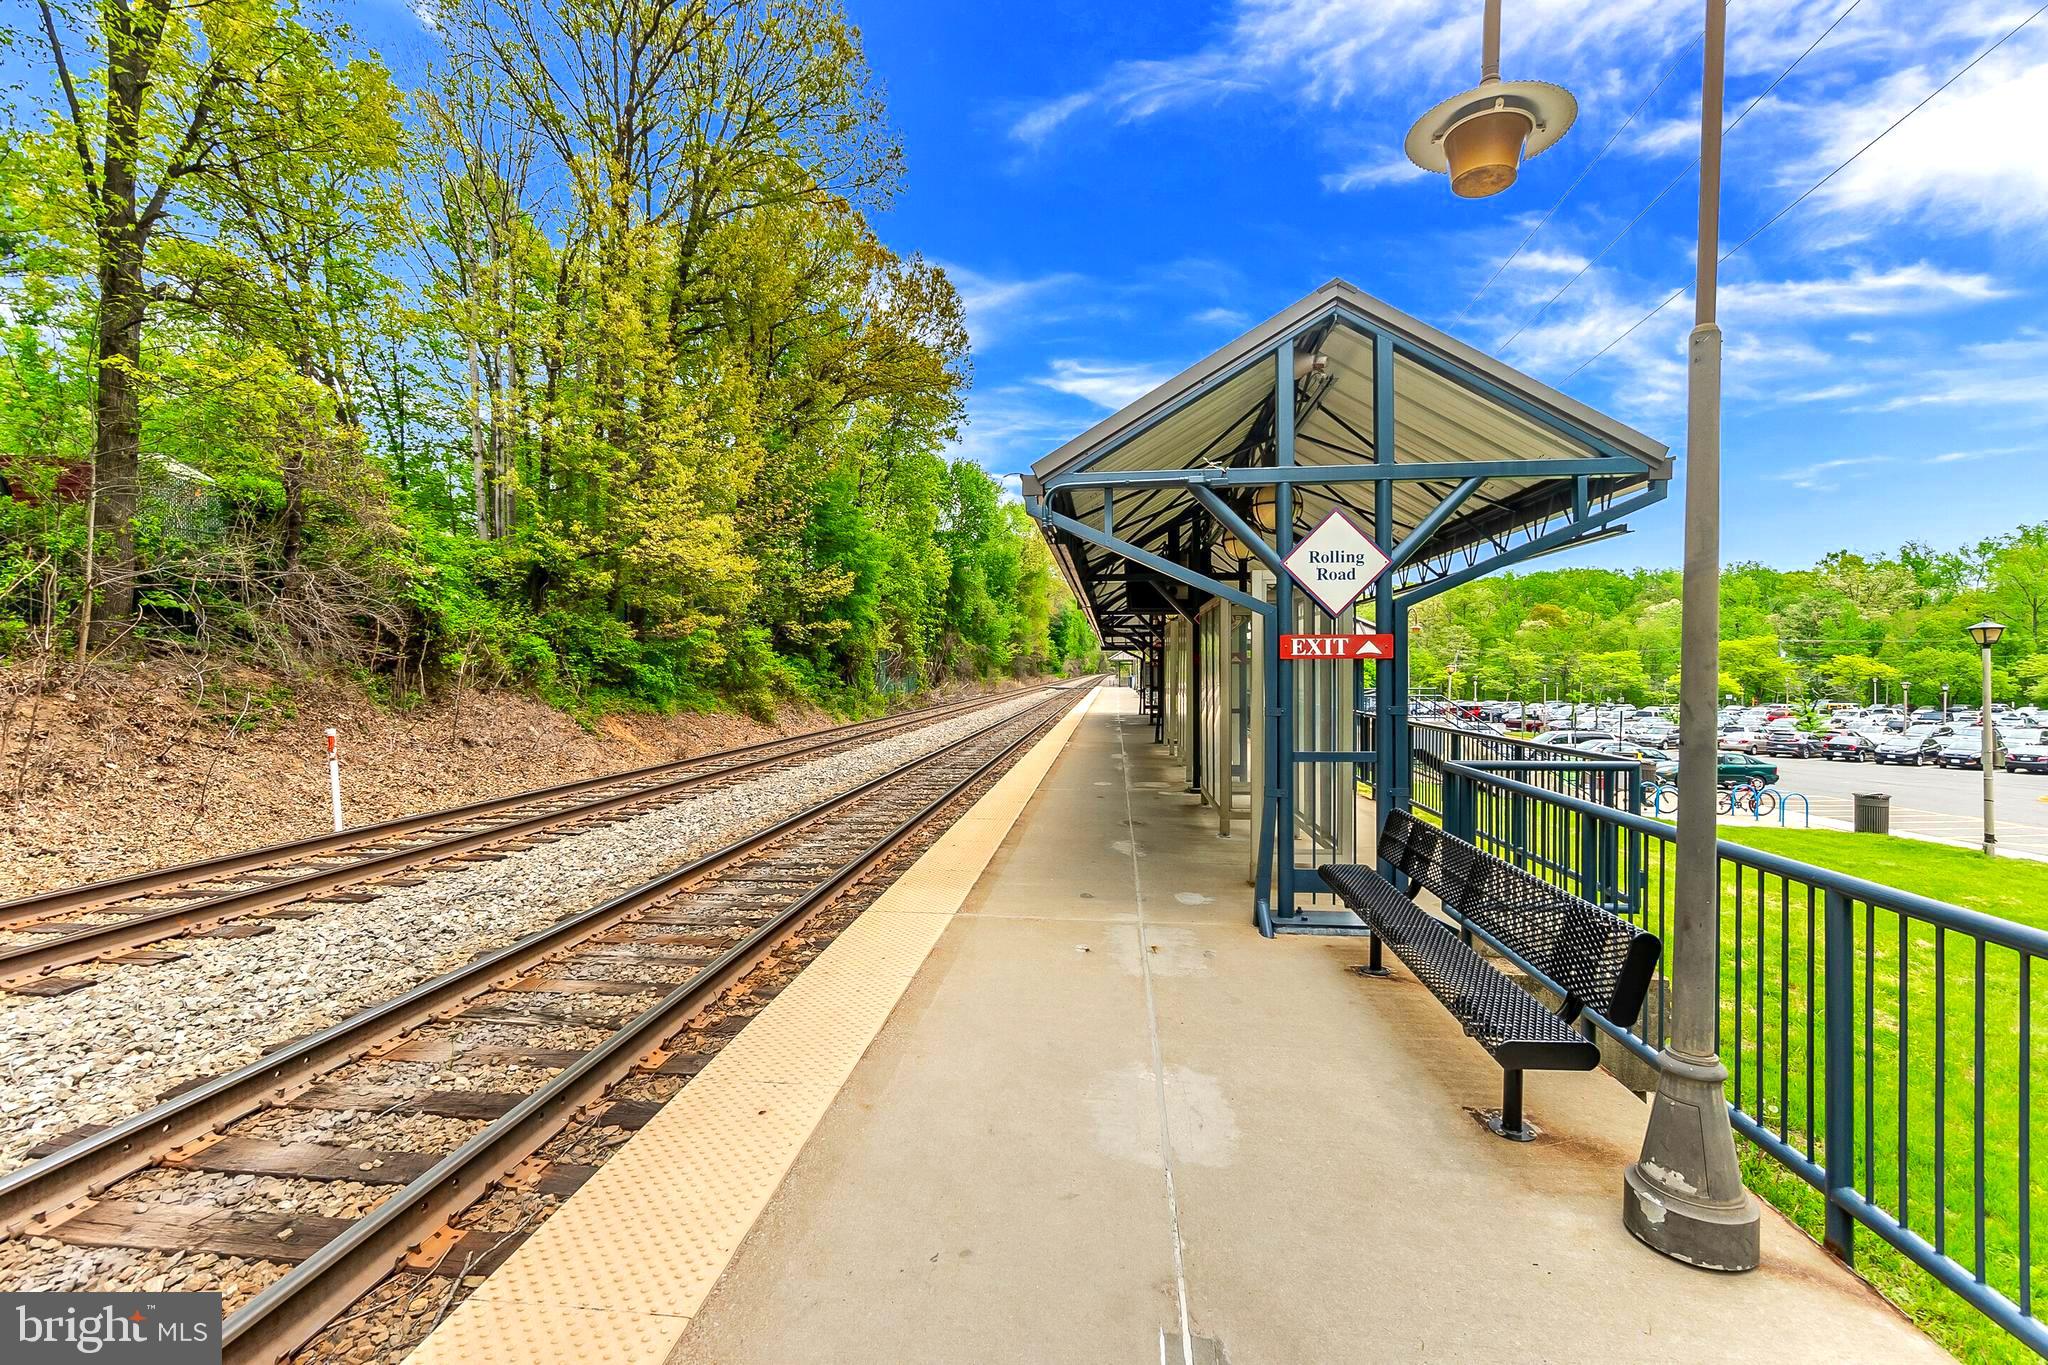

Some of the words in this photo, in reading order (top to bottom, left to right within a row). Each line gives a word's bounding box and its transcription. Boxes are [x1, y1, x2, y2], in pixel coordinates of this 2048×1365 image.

[1308, 550, 1365, 566] Rolling
[1316, 567, 1356, 581] Road
[1291, 638, 1349, 656] EXIT
